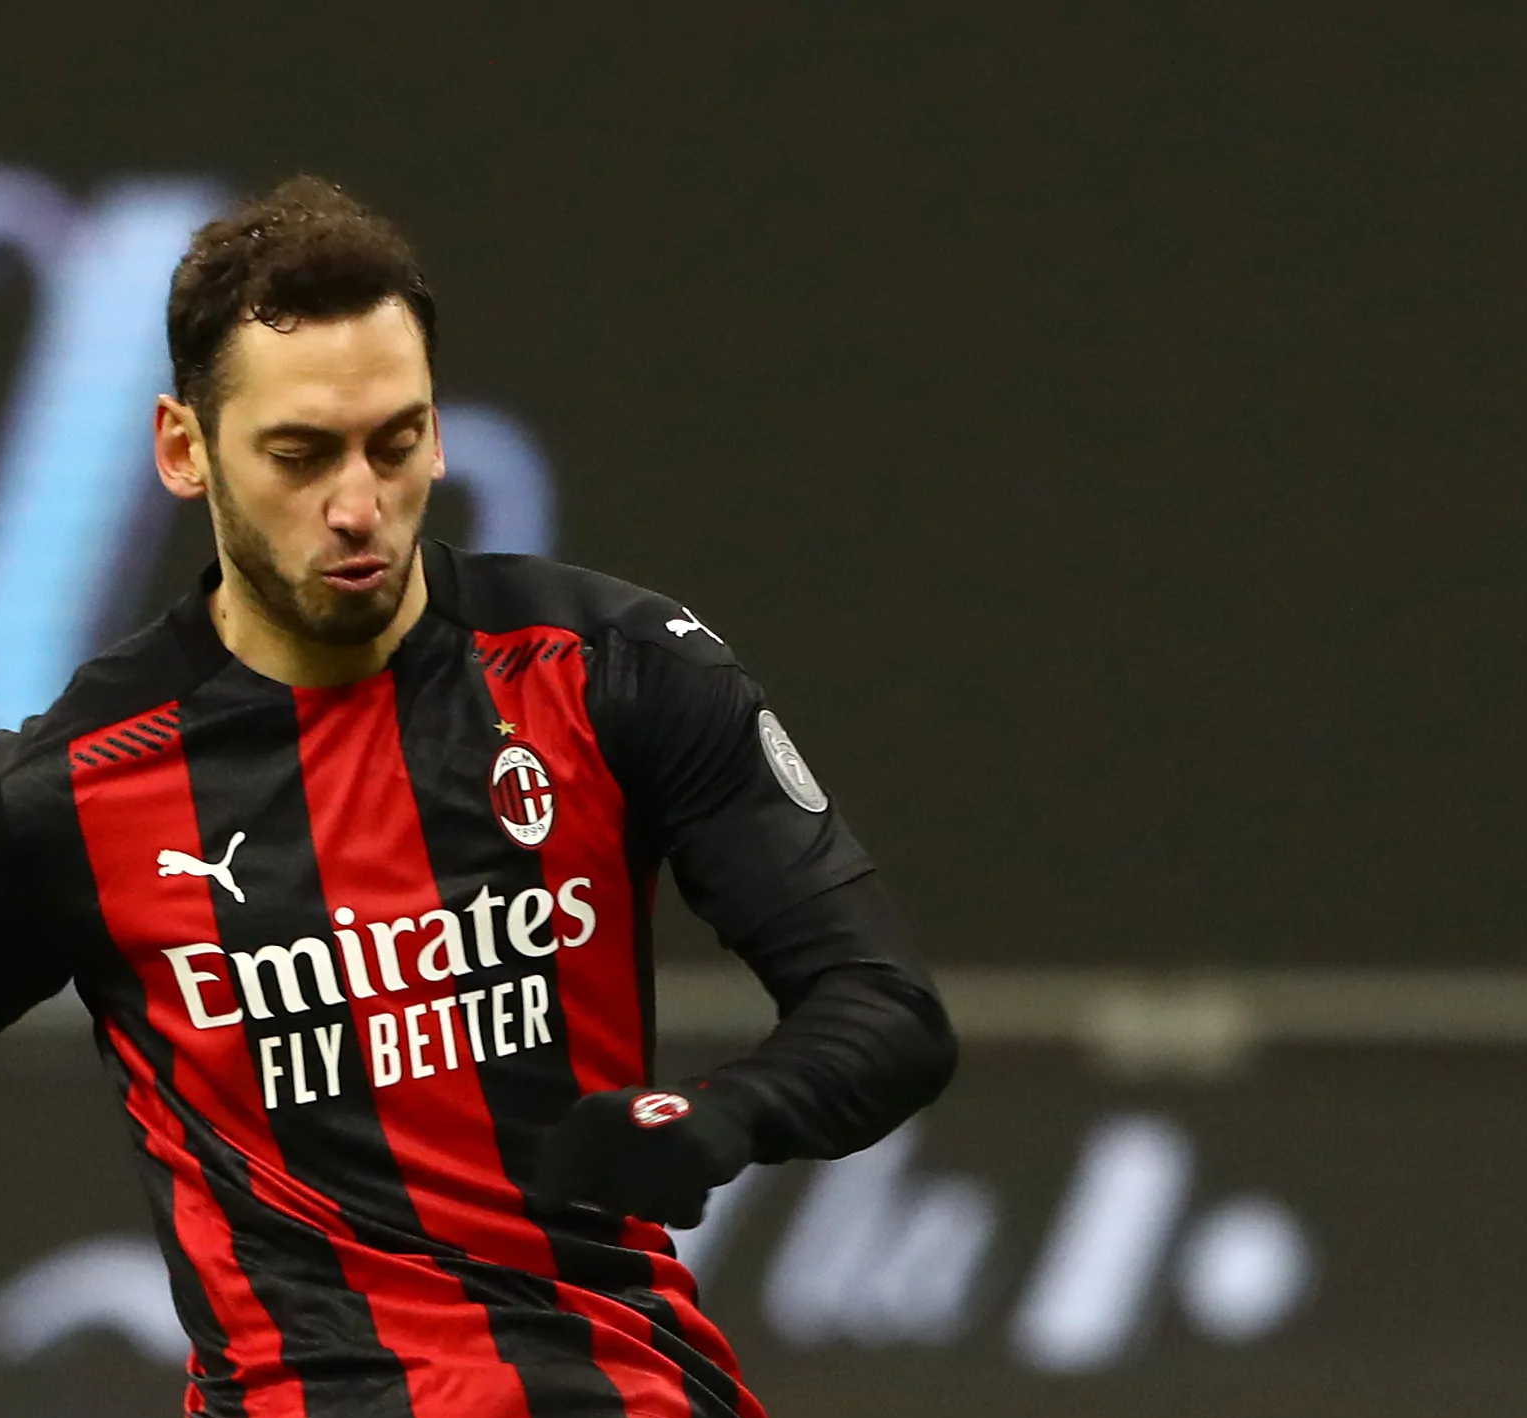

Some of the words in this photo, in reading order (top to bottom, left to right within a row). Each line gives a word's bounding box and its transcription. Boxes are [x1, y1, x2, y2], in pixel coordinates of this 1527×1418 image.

[161, 876, 597, 1030] Emirates
[259, 1023, 343, 1109] FLY
[368, 974, 553, 1089] BETTER
